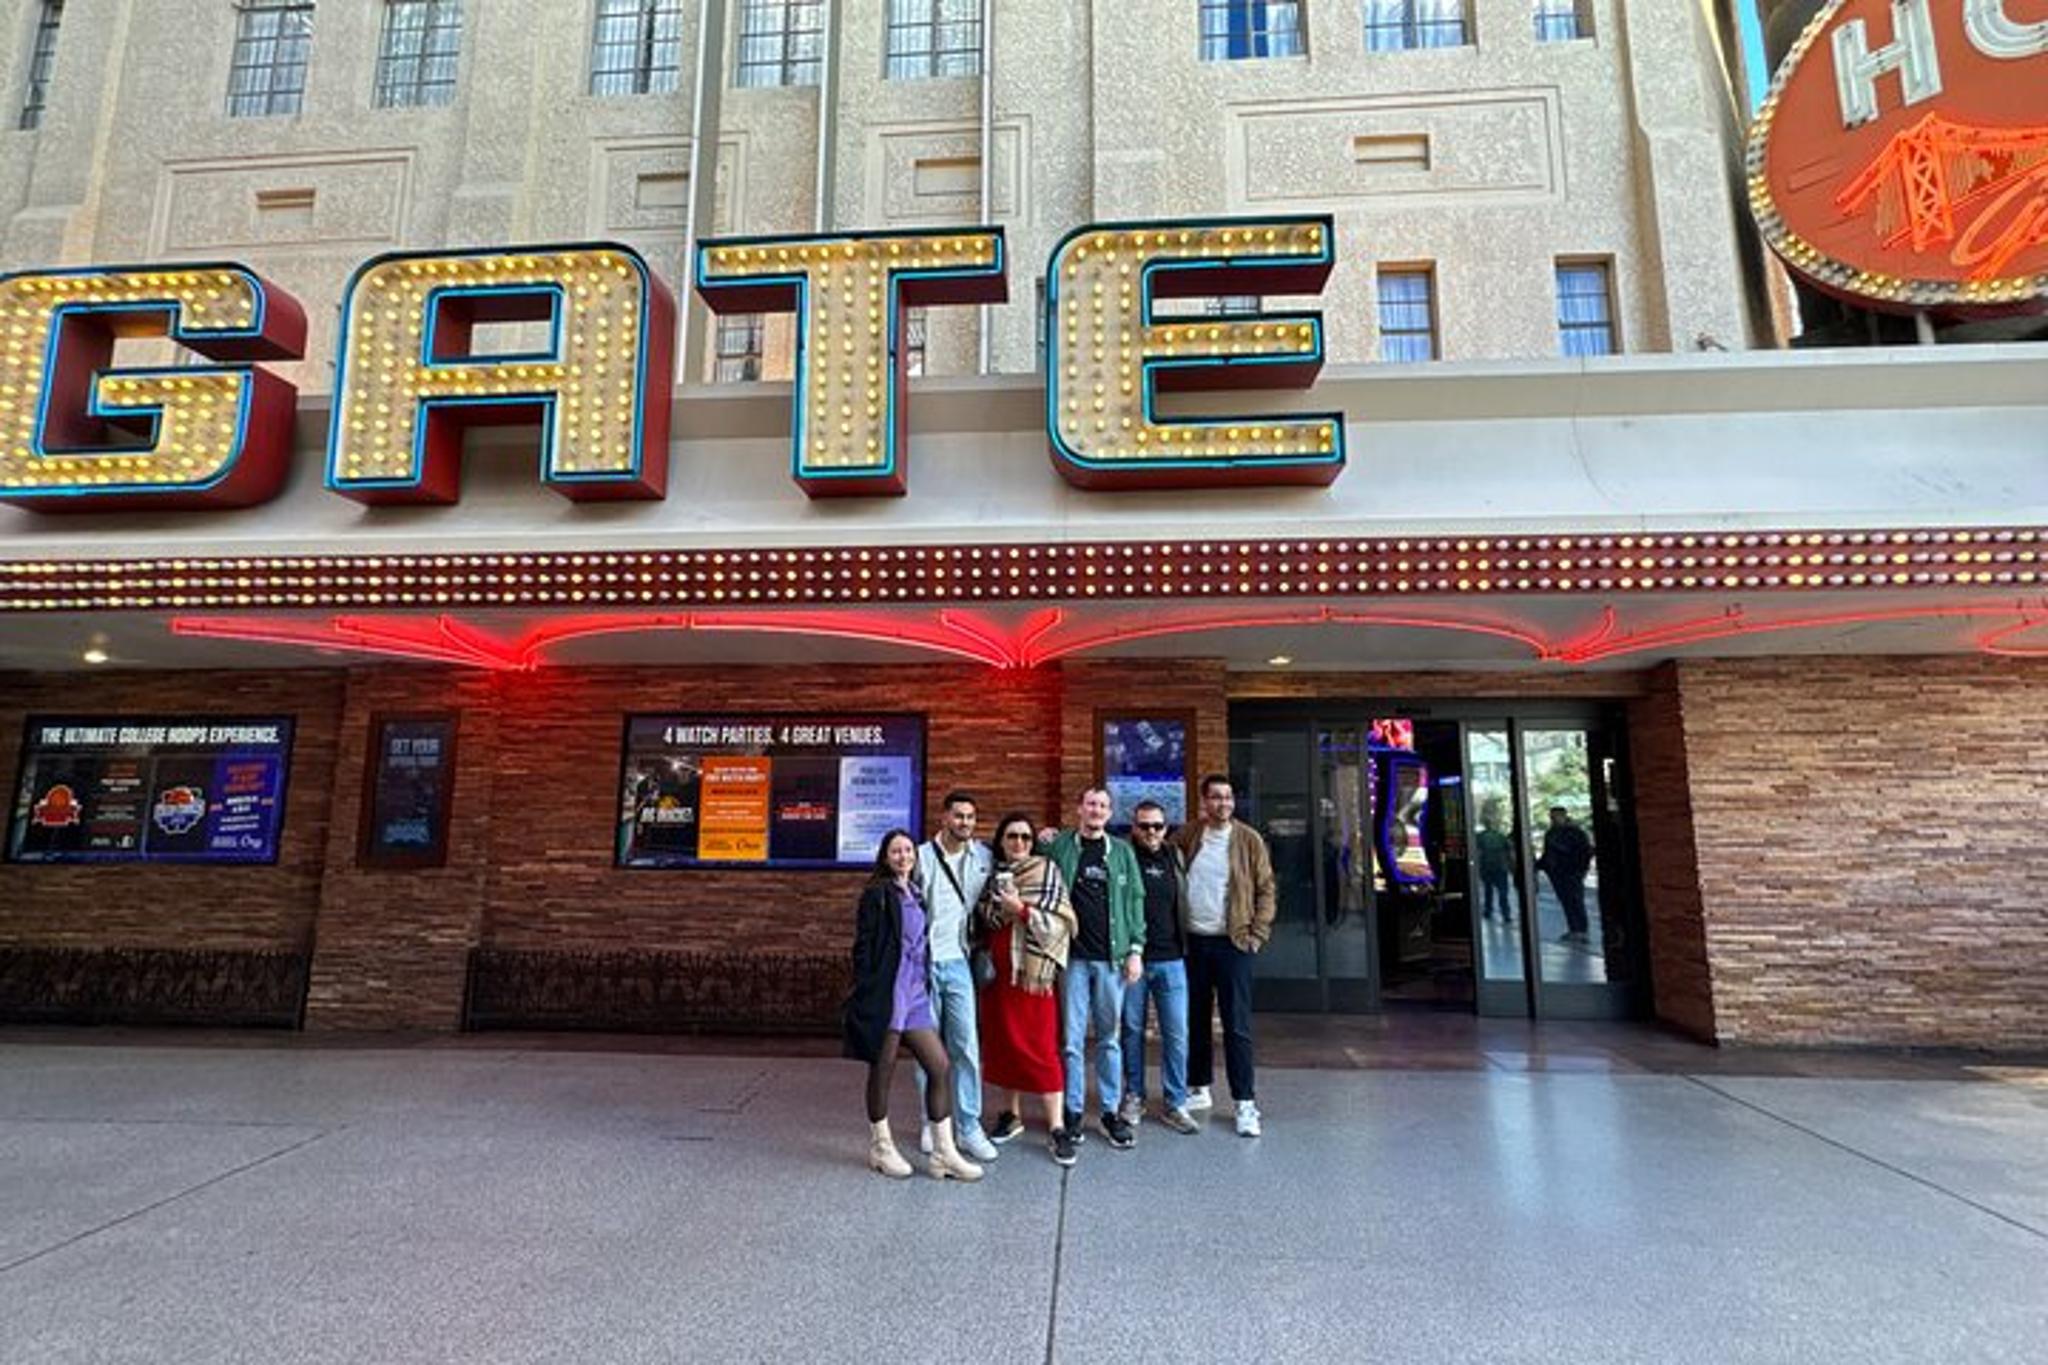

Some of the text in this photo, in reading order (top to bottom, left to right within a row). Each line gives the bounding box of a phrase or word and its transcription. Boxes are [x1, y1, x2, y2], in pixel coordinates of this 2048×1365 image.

[0, 214, 1346, 508] GATE
[41, 726, 280, 743] THE ULTIMATE COLLEGE HOOPS EXPERIENCE.
[662, 726, 886, 744] 4 WATCH PARTIES. 4 GREAT VENUES.
